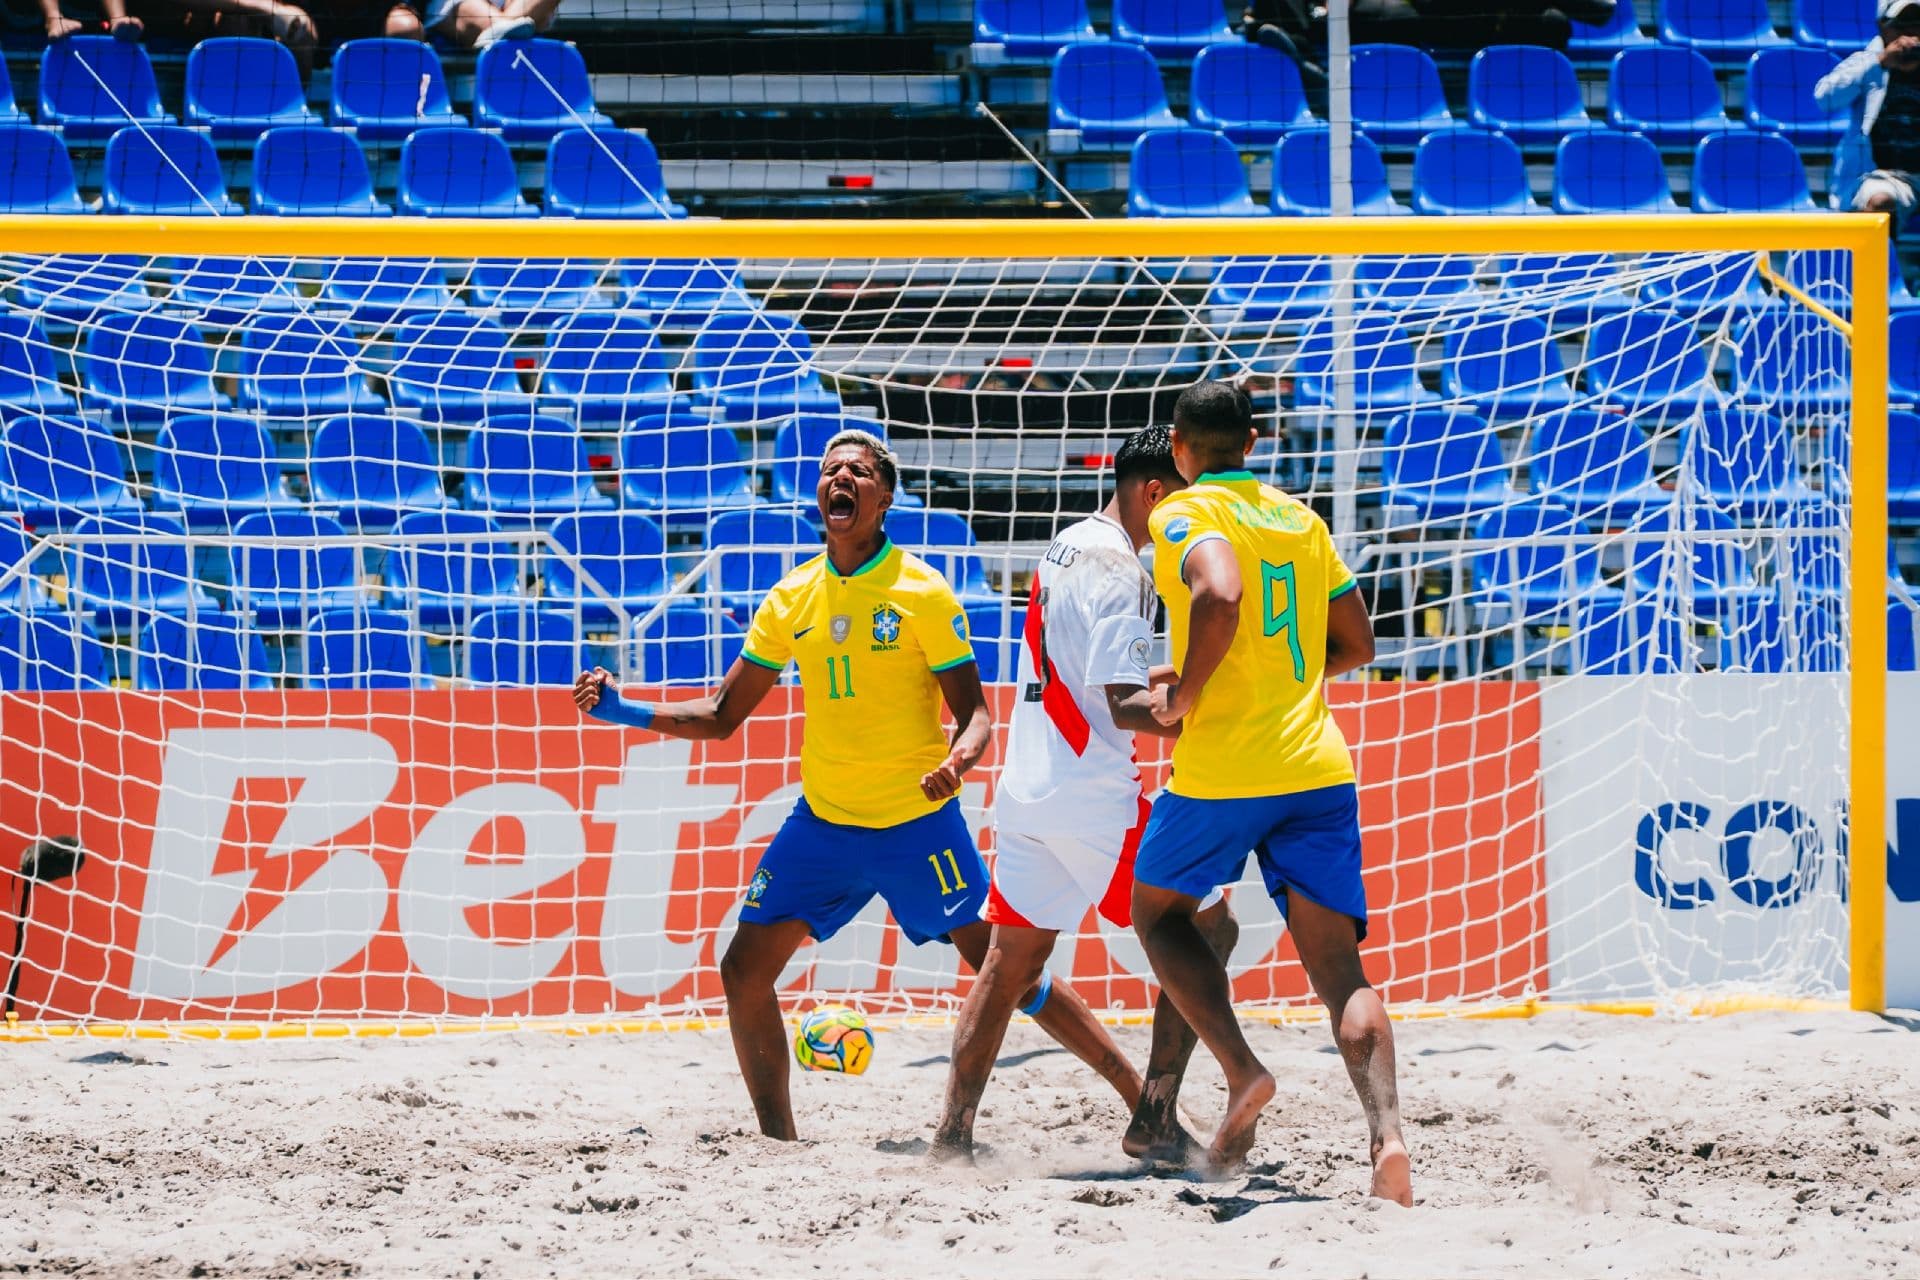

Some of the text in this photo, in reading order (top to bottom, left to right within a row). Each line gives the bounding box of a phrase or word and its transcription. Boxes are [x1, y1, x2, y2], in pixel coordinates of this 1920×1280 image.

[1261, 558, 1305, 683] 9
[826, 655, 856, 699] 11
[928, 848, 968, 896] 11
